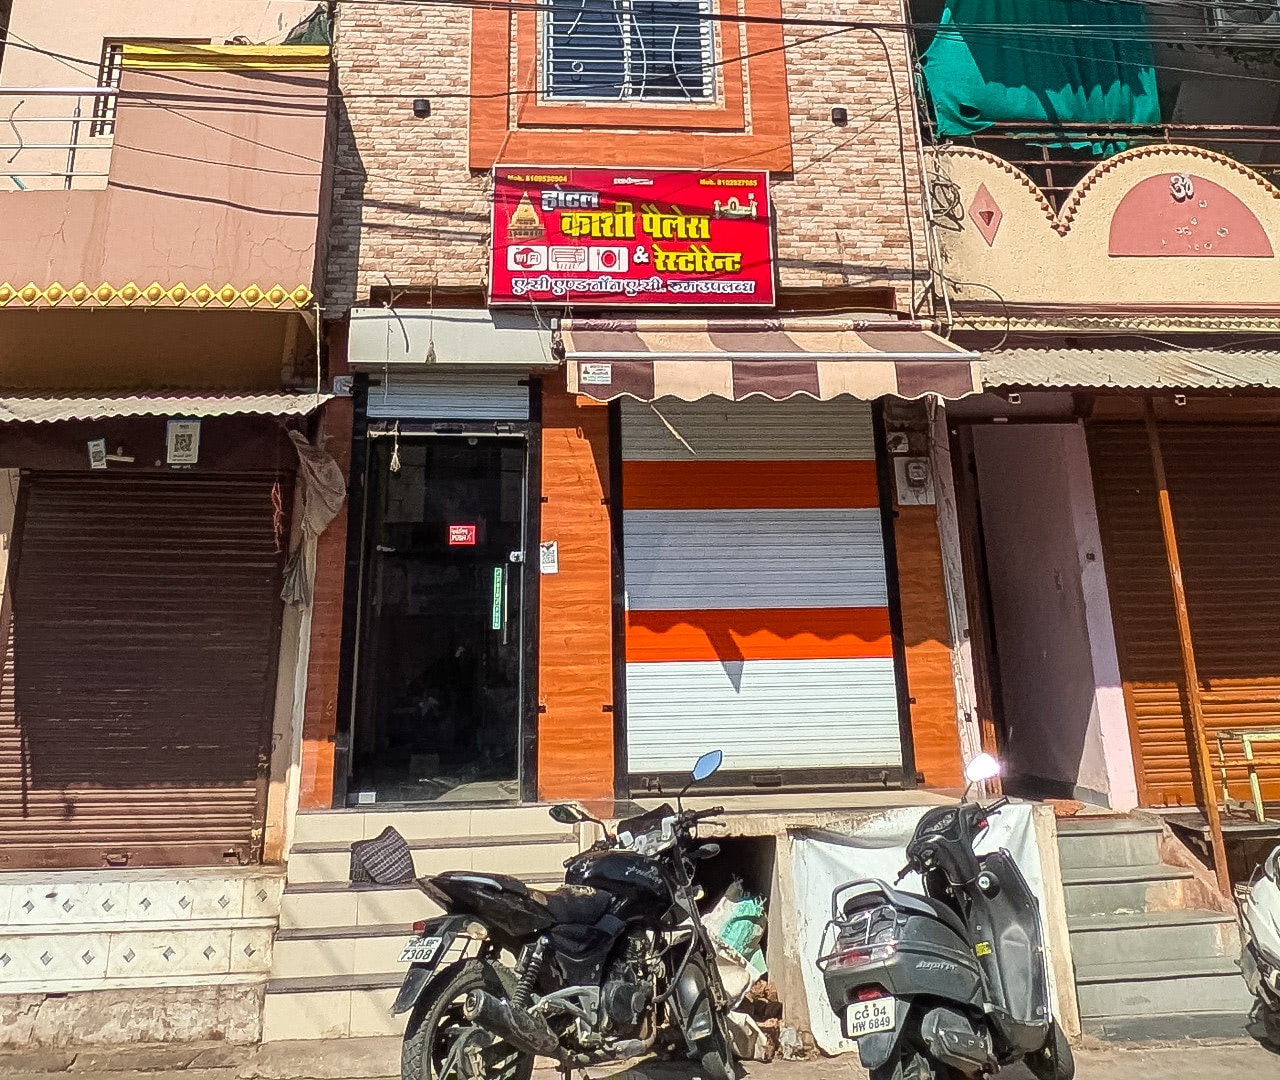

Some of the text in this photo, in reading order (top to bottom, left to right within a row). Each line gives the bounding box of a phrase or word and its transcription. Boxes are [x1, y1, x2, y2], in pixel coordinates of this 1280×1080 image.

[540, 185, 599, 210] होटल
[560, 202, 711, 239] काशी पैलेस
[633, 243, 742, 273] & रेस्टोरेन्ट
[401, 949, 432, 961] 7308
[854, 1006, 886, 1020] CG 04
[852, 1016, 891, 1033] HW 6849
